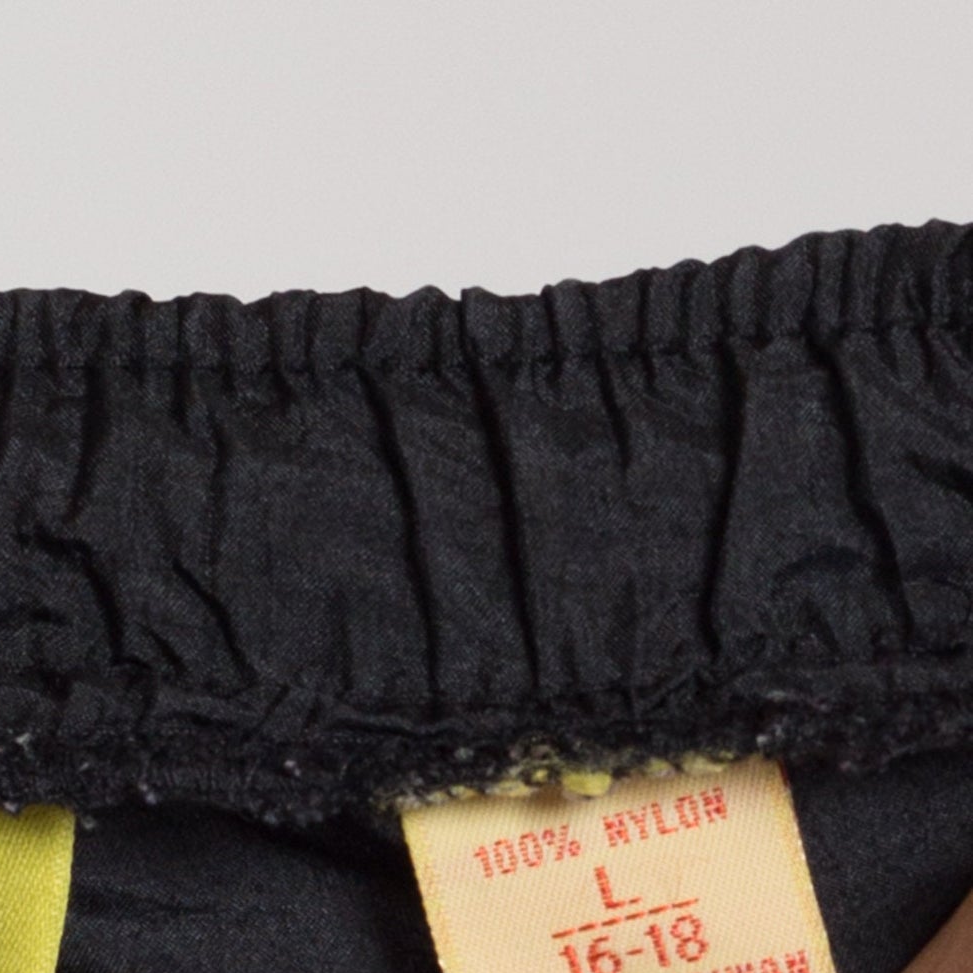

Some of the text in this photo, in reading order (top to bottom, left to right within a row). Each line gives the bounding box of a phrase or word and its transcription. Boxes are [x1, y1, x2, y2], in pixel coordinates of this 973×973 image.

[473, 787, 728, 879] 100% NYLON
[594, 865, 642, 910] L
